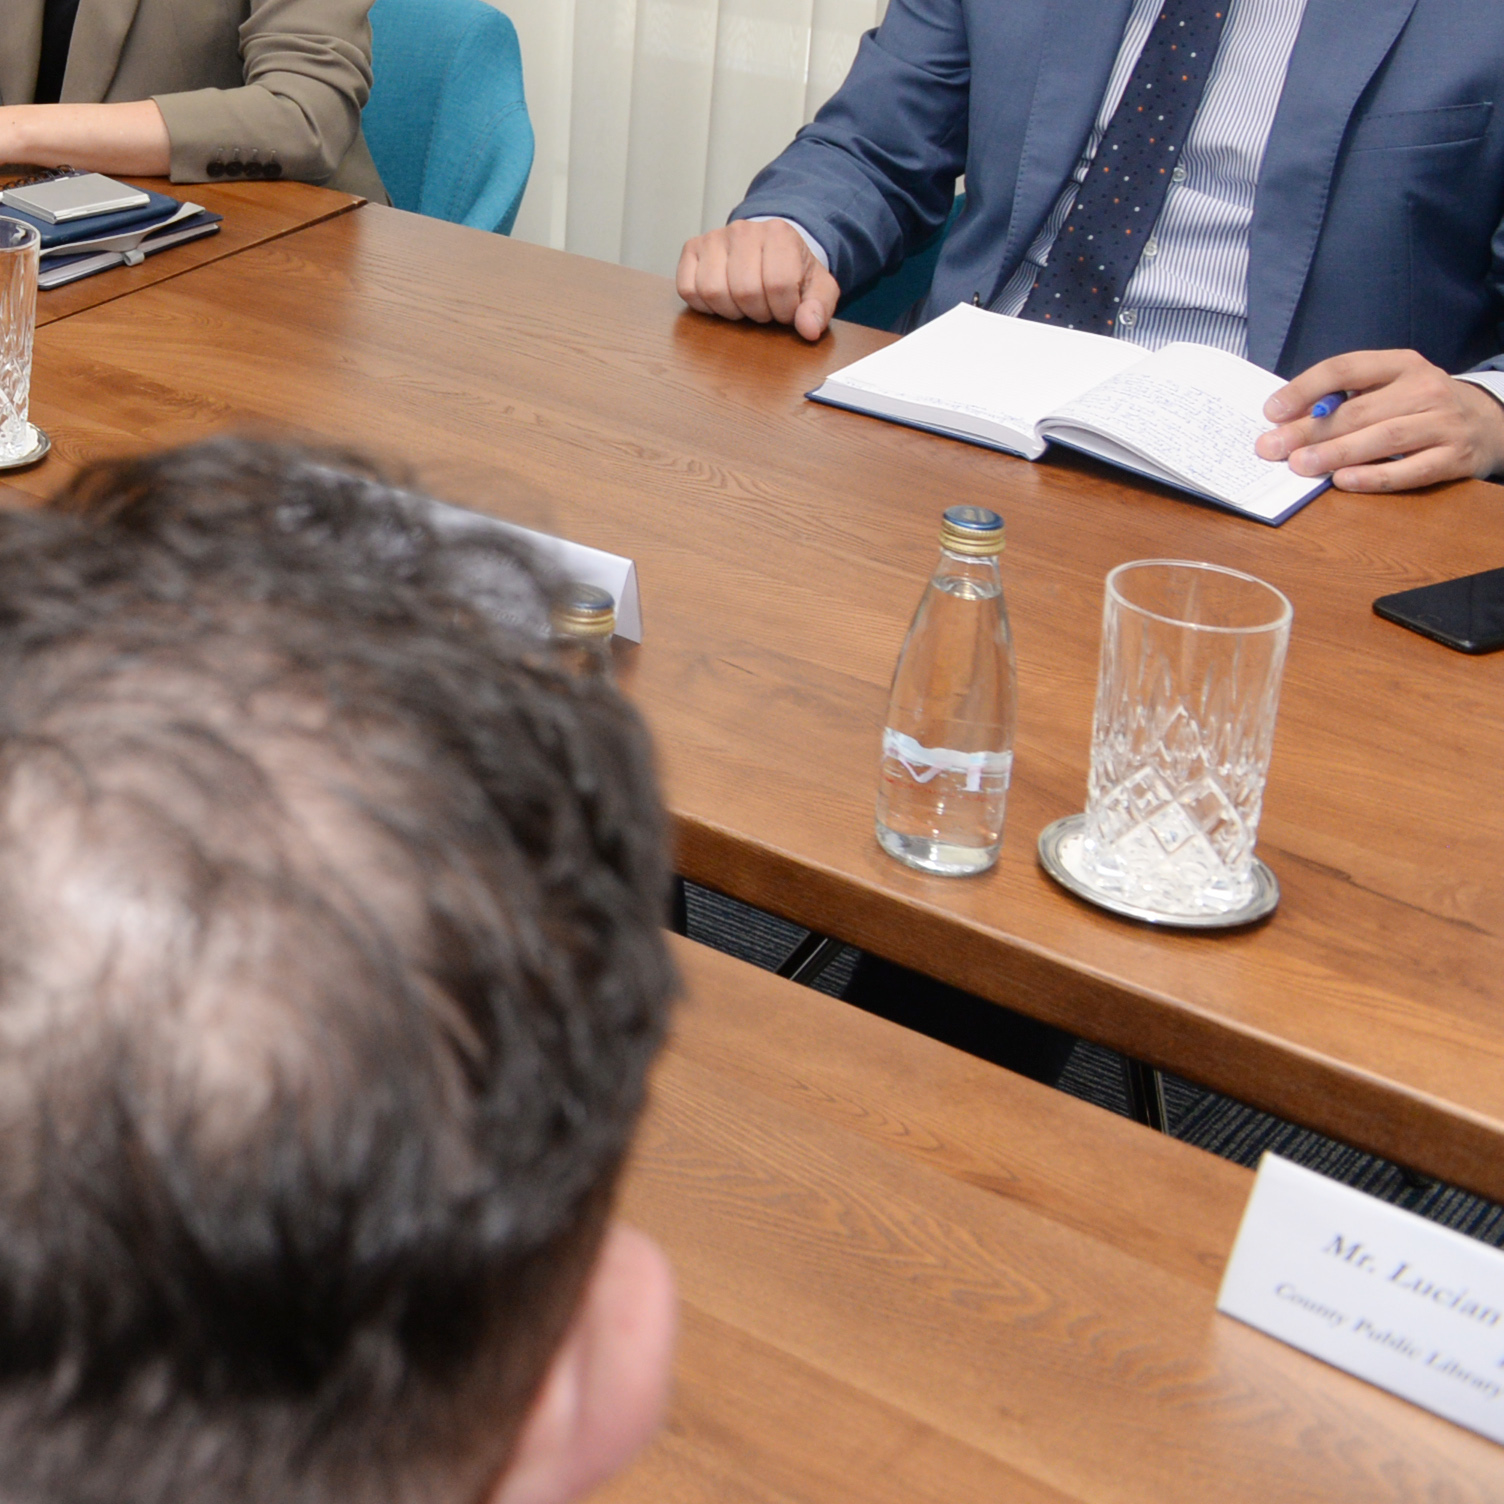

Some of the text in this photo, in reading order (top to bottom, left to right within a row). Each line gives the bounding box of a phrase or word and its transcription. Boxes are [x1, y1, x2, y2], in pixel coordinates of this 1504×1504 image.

[1322, 1234, 1501, 1327] Mr. Lucian
[1274, 1283, 1502, 1397] County Public Library
